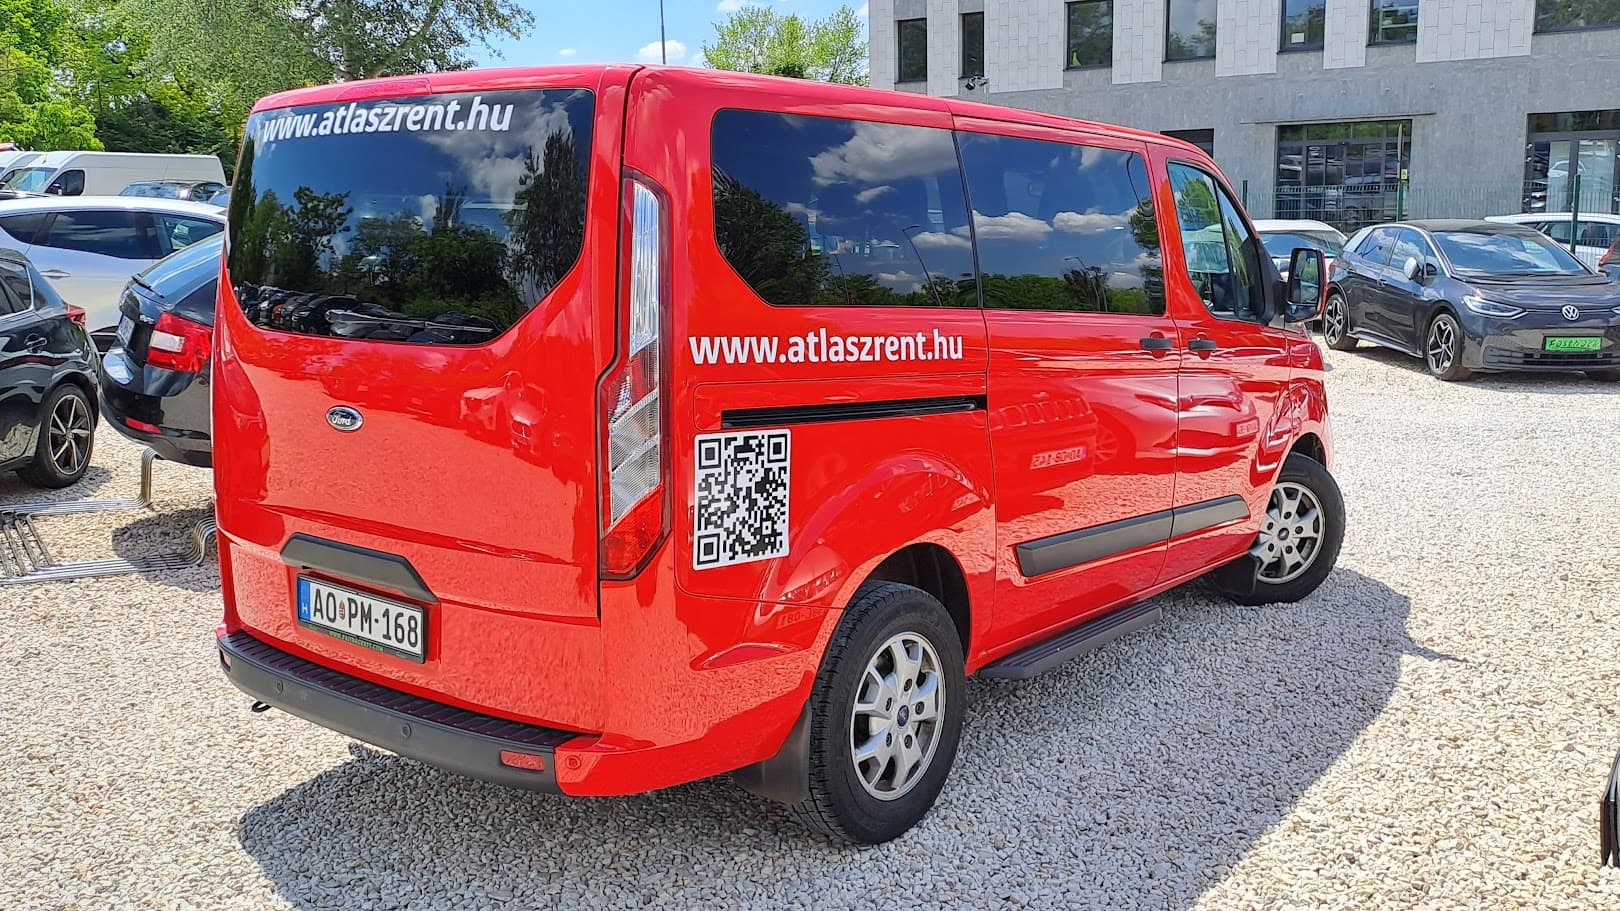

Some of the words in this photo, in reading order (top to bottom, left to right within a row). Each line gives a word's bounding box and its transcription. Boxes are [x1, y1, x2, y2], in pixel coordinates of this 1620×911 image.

[263, 96, 514, 142] www.atlaszrent.hu
[688, 327, 963, 364] www.atlaszrent.hu
[301, 602, 309, 614] H
